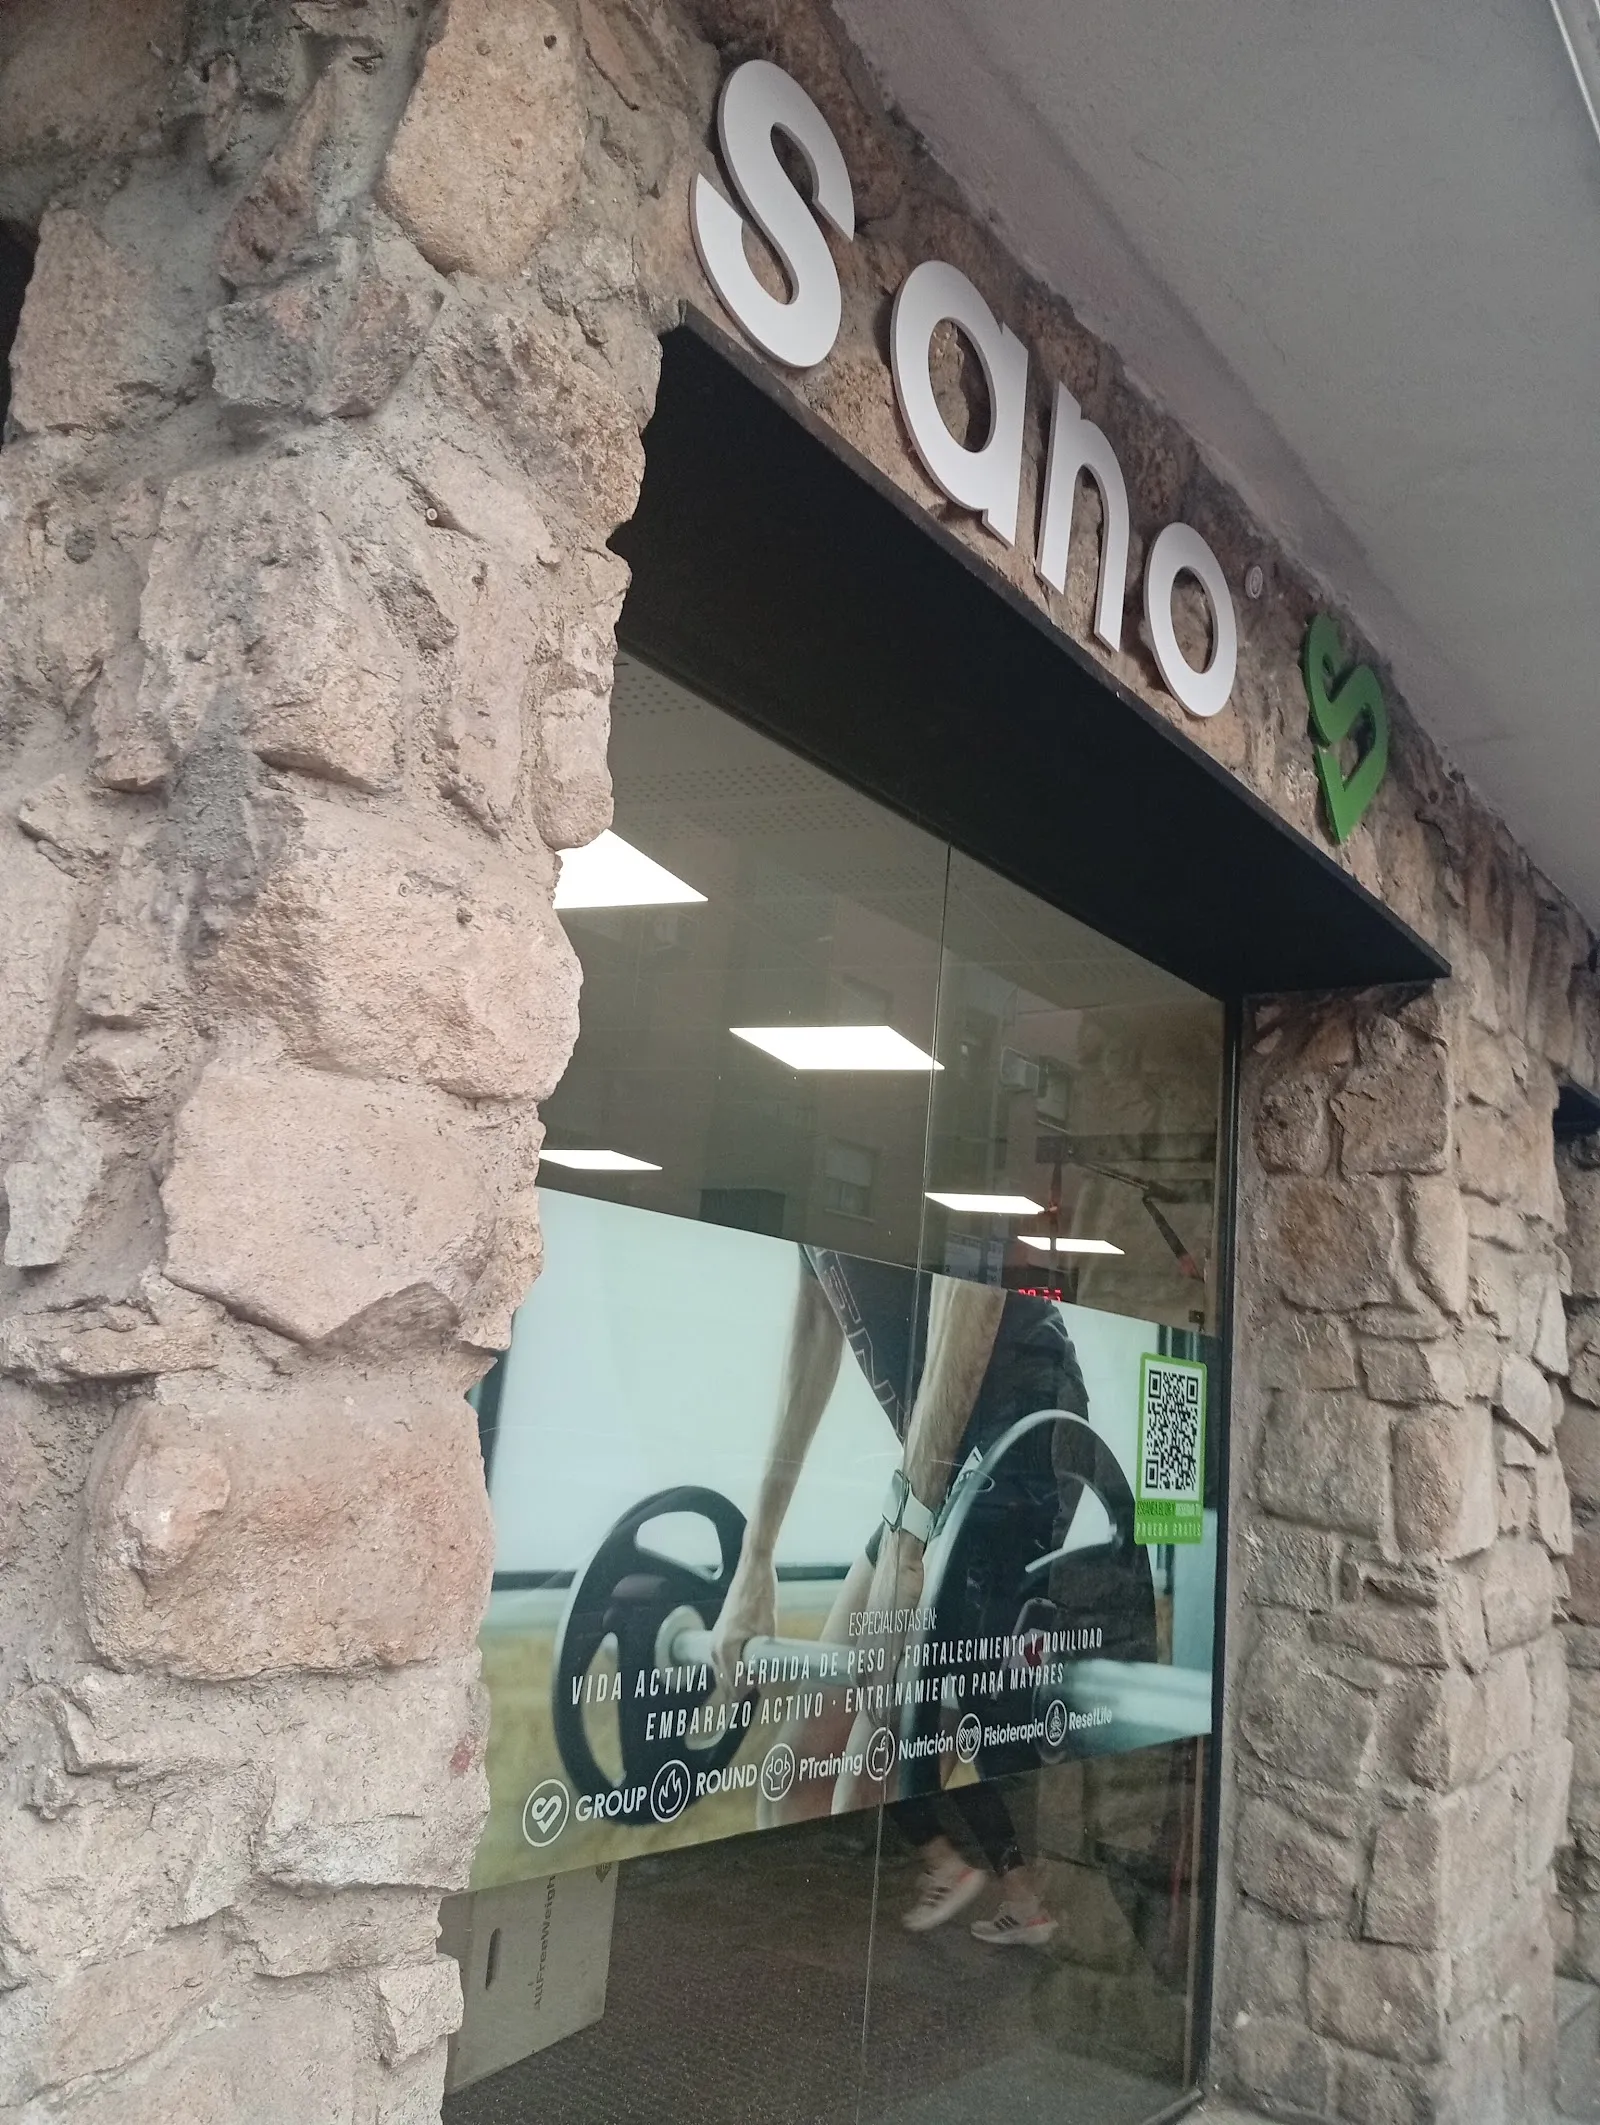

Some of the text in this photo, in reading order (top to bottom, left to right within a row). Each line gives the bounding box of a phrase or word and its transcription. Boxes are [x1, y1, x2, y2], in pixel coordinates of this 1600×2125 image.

[848, 1607, 921, 1637] ESPECIALISTAS
[570, 1627, 1103, 1705] VIDA ACTIVA PÉRDIDA DE PESO FORTALECIMIENTO Y MOVILIDAD
[644, 1700, 751, 1742] EMBARAZO
[760, 1691, 823, 1725] ACTIVO
[971, 1669, 1004, 1697] PARA
[1010, 1662, 1064, 1691] MAYORES
[574, 1786, 648, 1822] GROUP
[695, 1764, 757, 1797] ROUND
[798, 1751, 863, 1781] PTraining
[898, 1729, 953, 1761] Nutrición
[983, 1718, 1044, 1747] Fisioterapia
